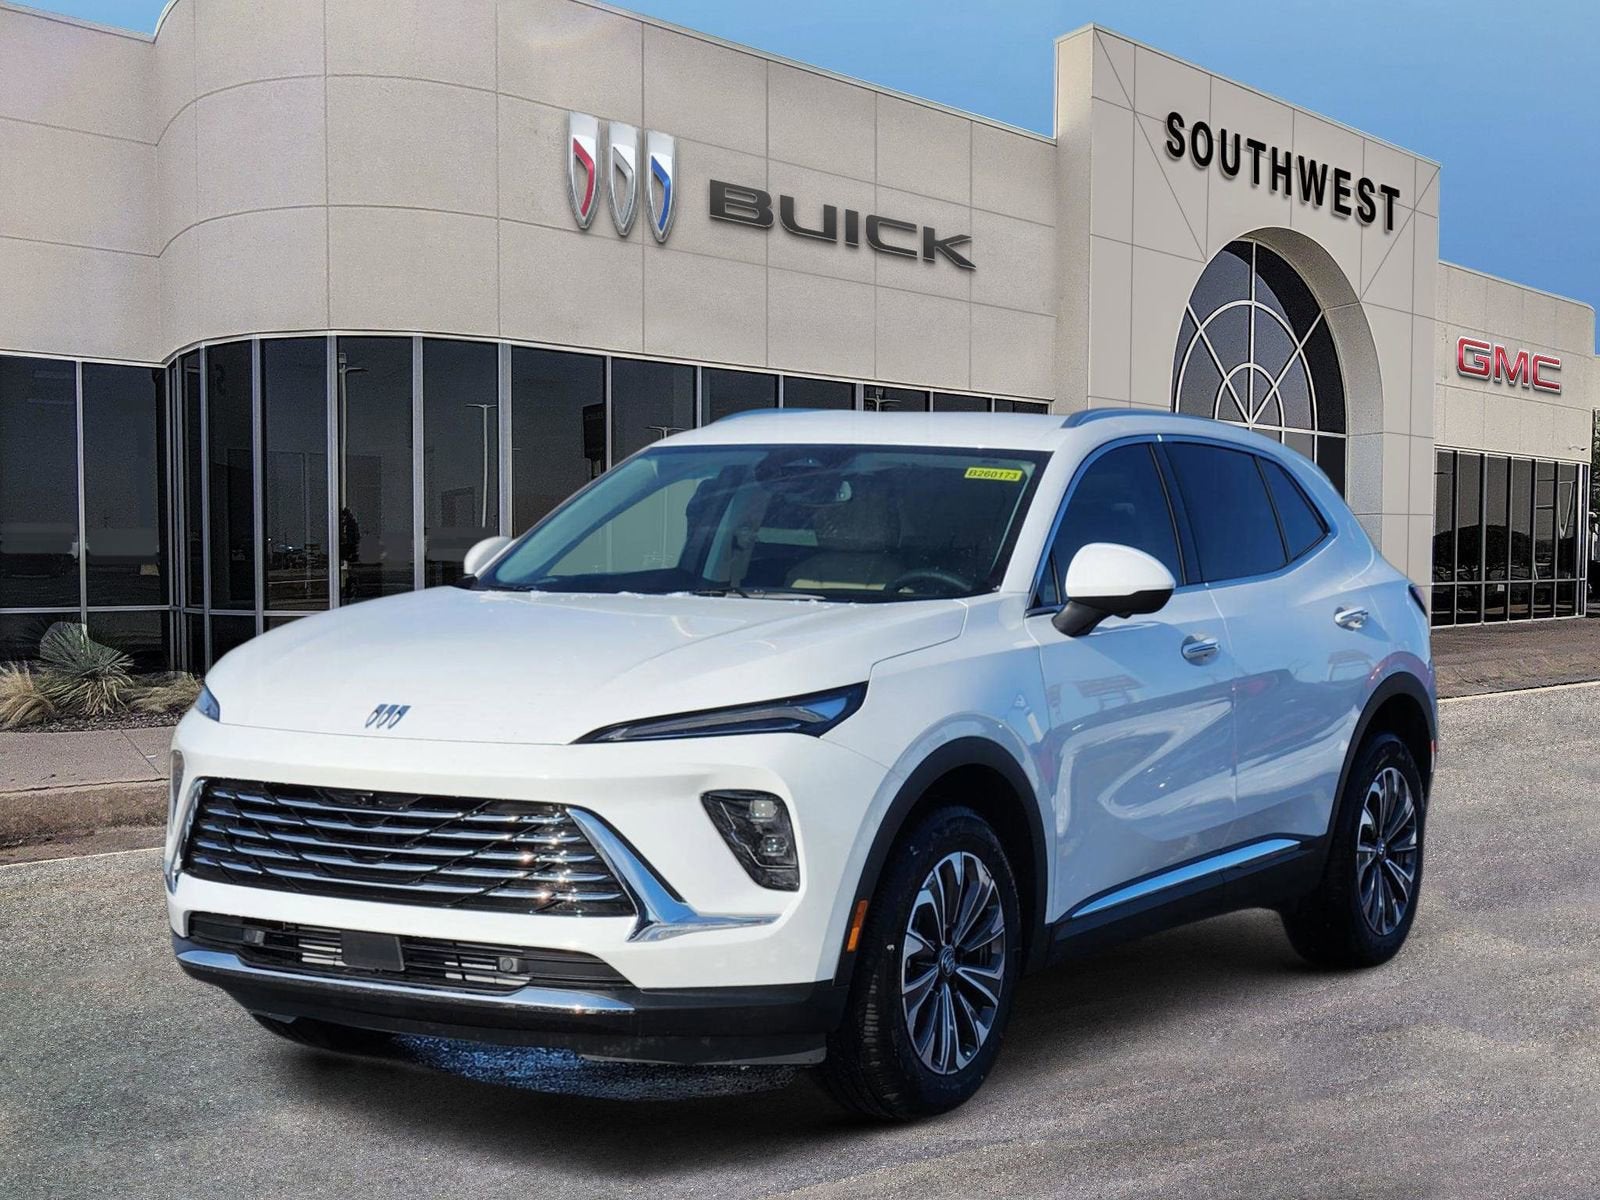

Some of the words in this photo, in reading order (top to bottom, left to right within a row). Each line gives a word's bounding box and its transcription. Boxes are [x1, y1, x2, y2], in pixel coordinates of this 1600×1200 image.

[1166, 111, 1400, 232] SOUTHWEST
[709, 178, 977, 270] BUICK
[1457, 335, 1561, 395] GMC
[967, 469, 1018, 479] B260173
